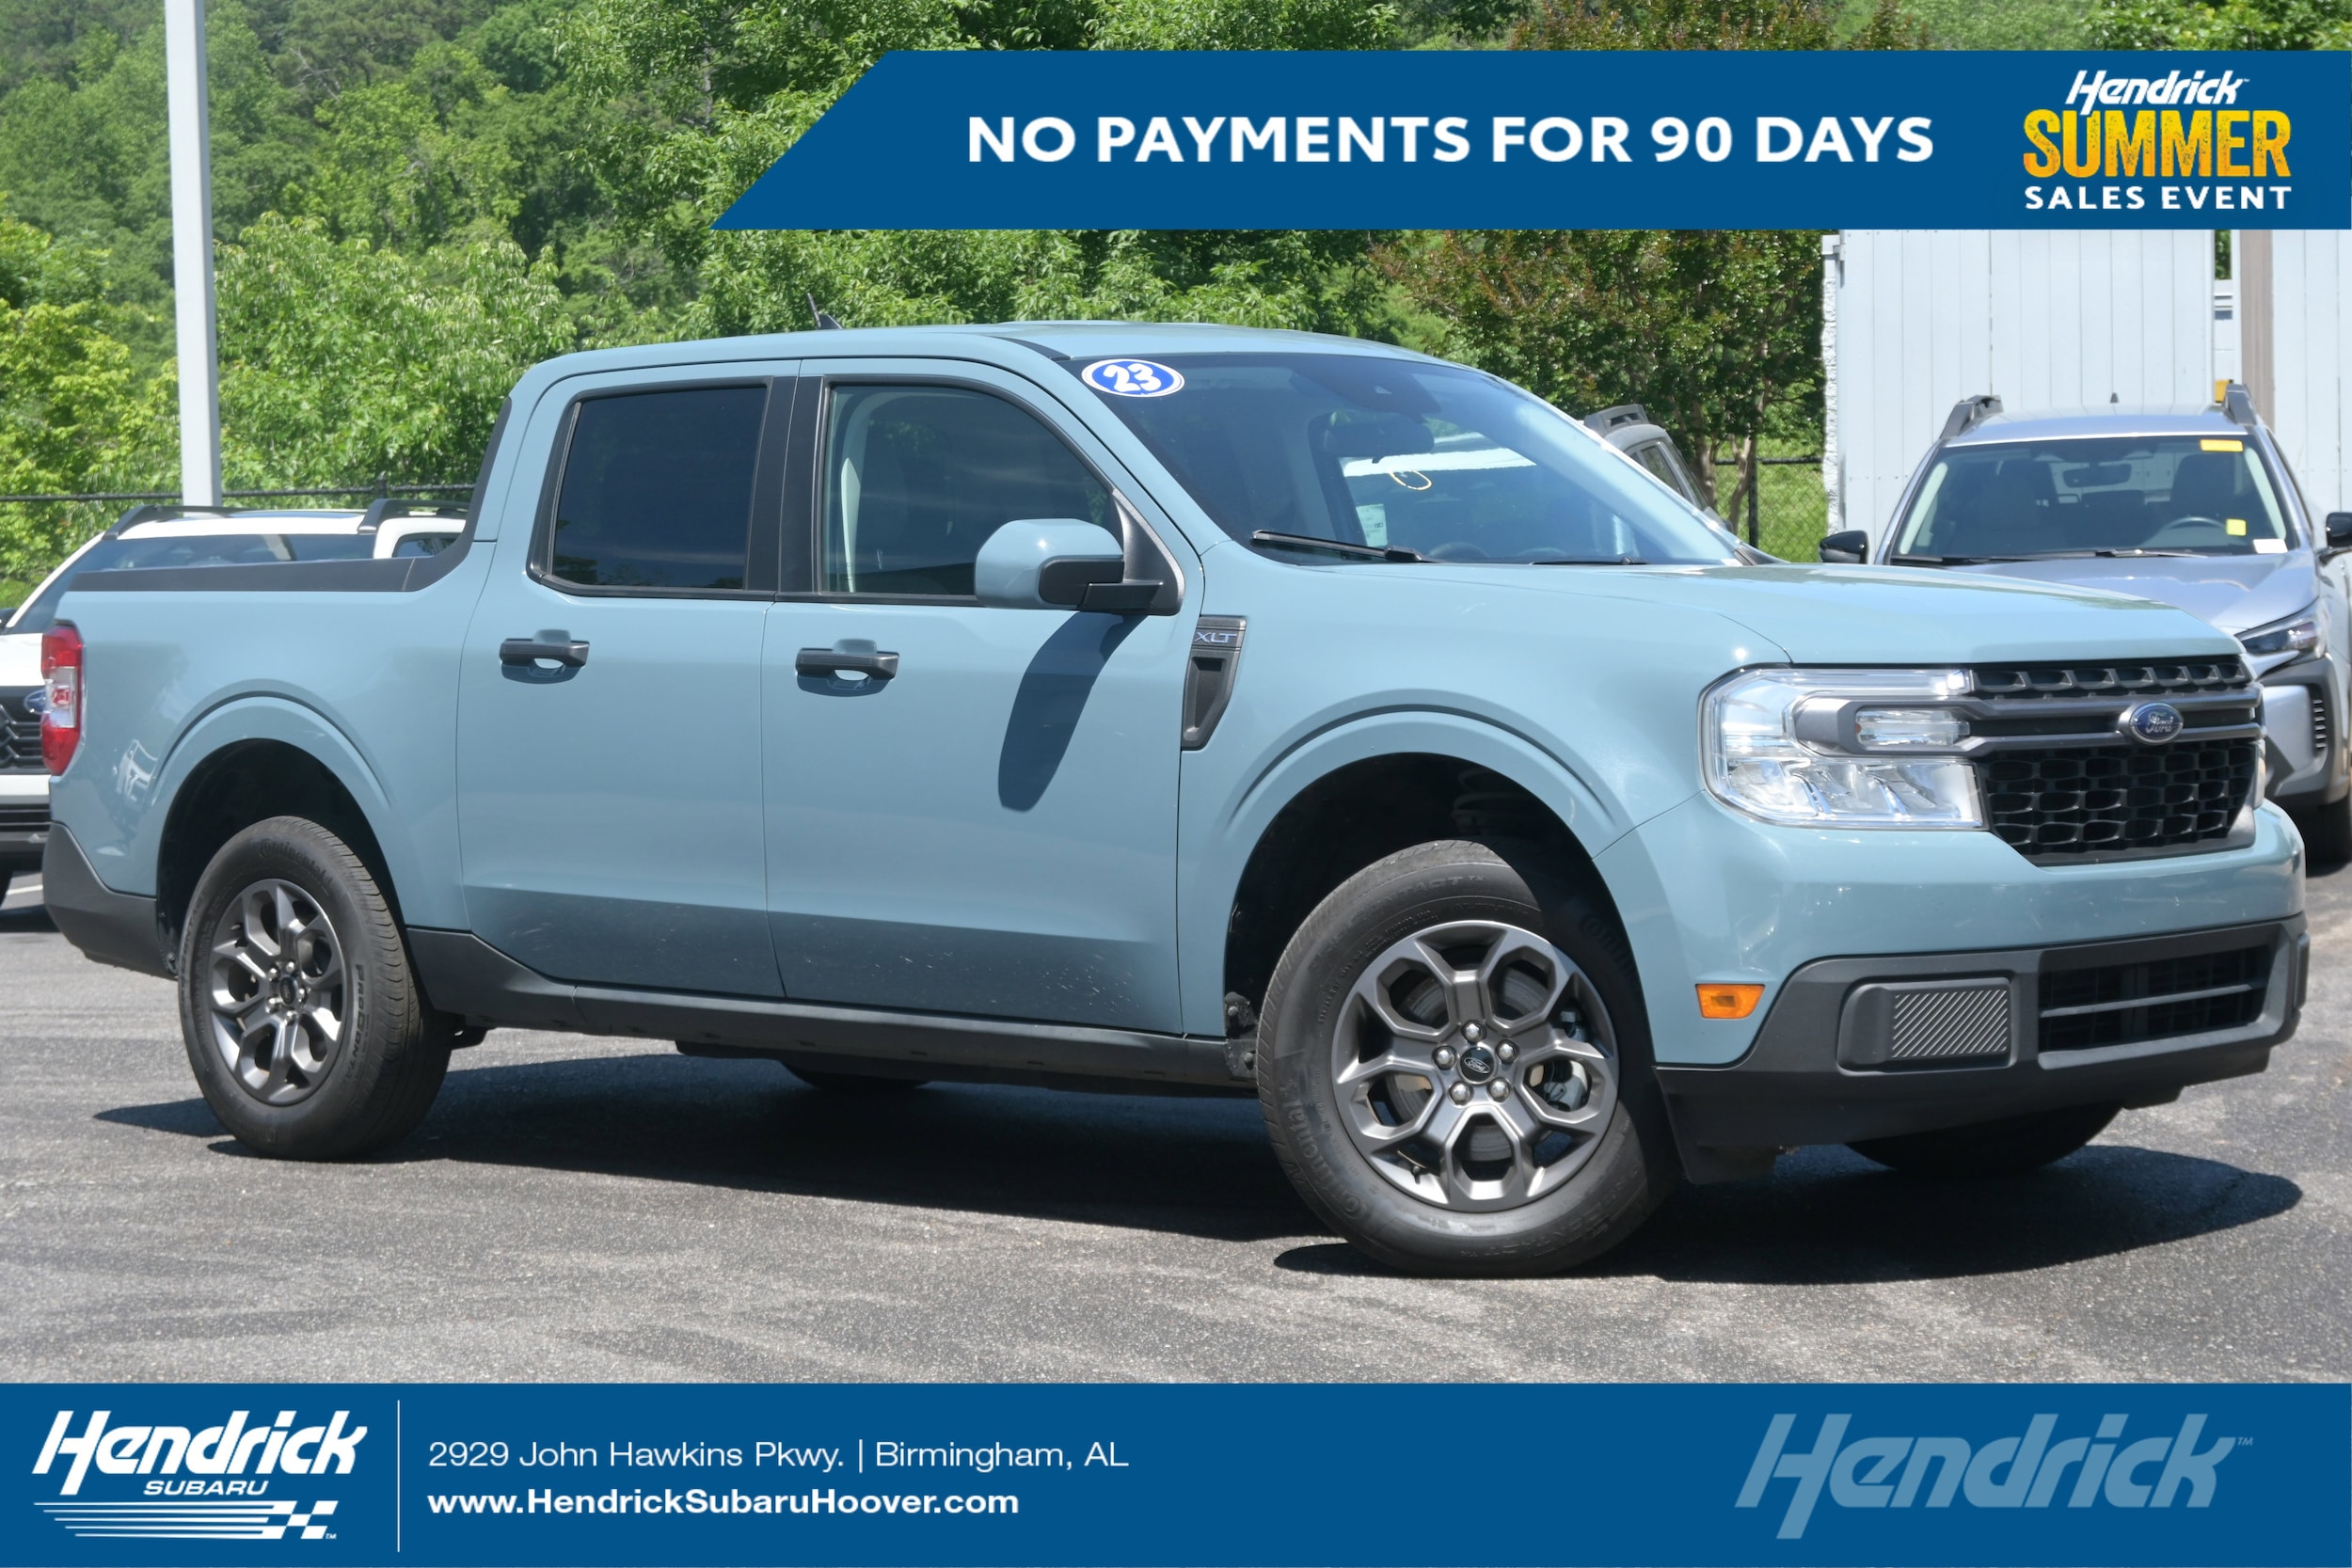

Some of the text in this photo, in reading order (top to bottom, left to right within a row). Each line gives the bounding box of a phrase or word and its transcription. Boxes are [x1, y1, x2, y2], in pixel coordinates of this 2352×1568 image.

[1103, 363, 1162, 392] 23
[1194, 631, 1237, 643] XLT
[2146, 711, 2174, 734] Ford
